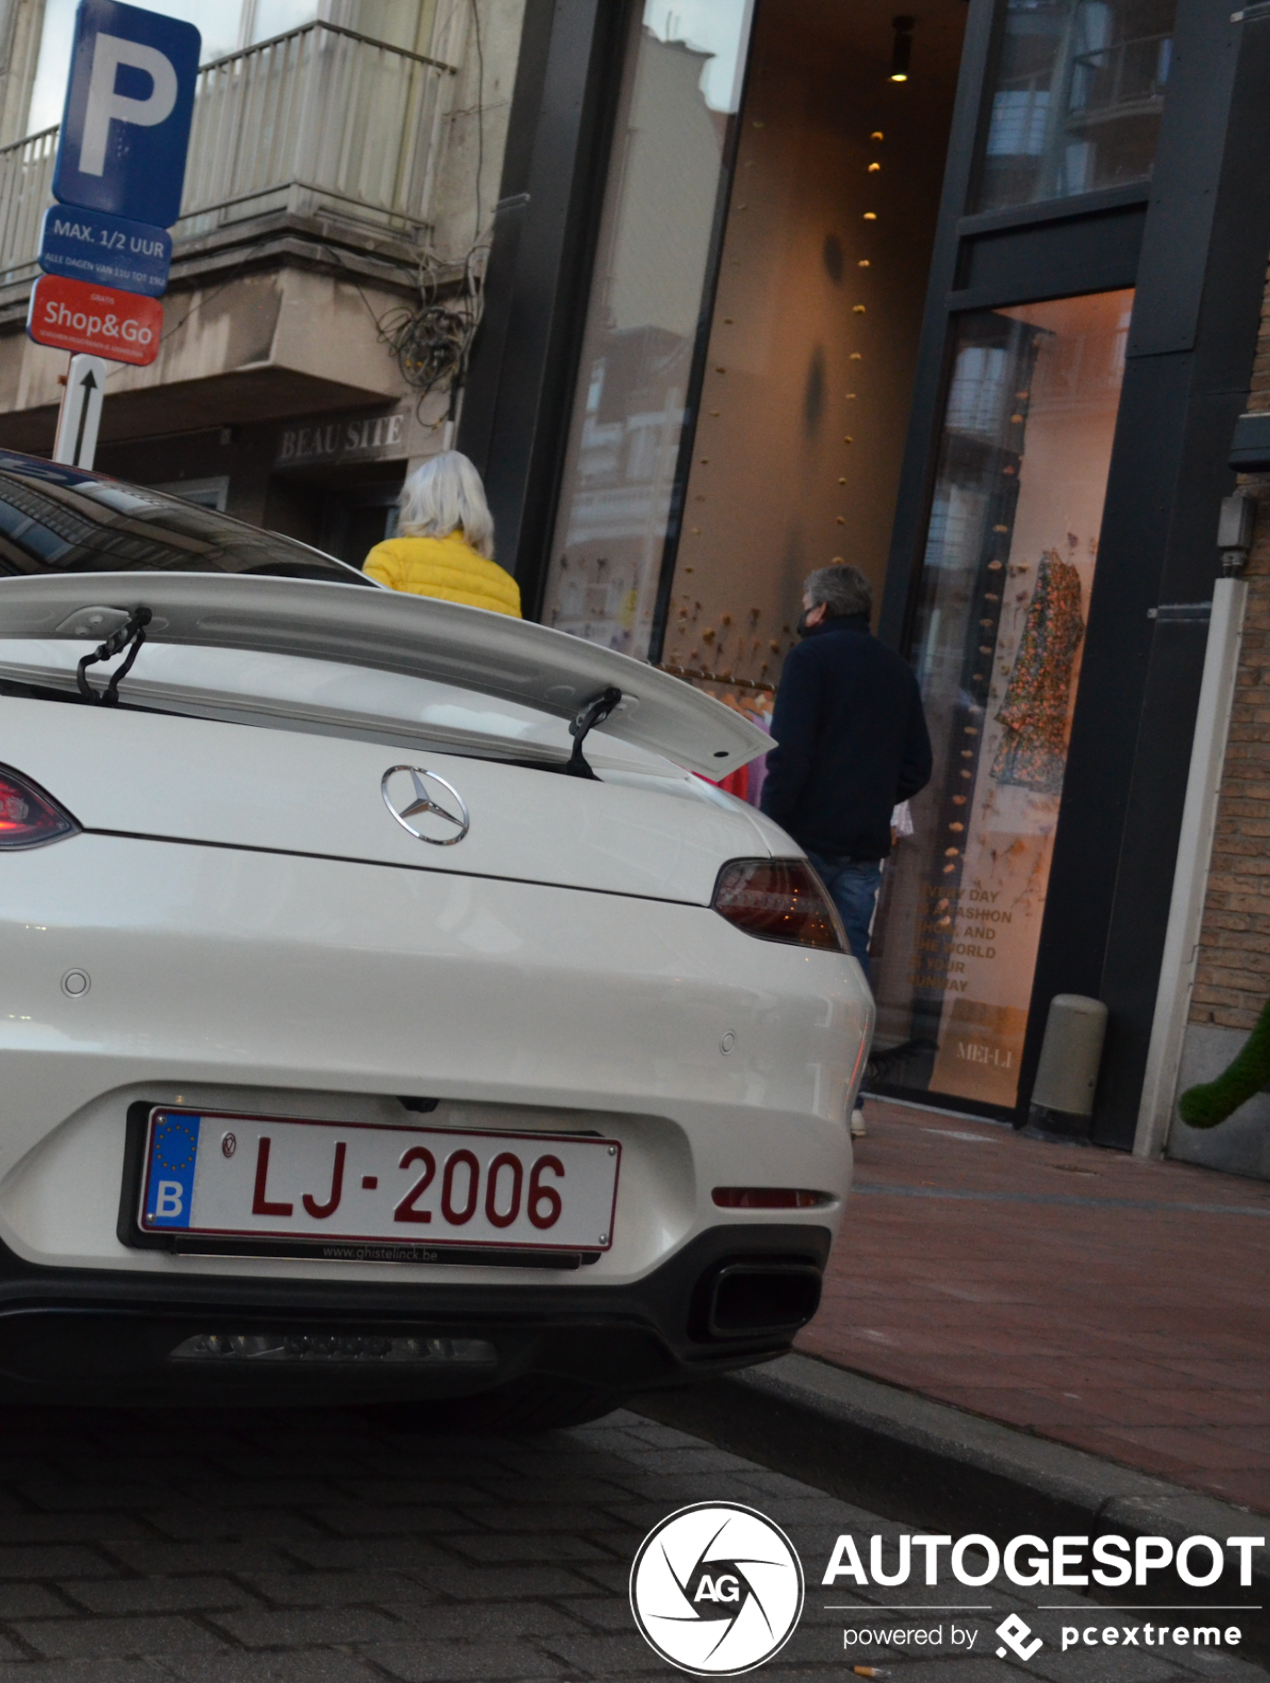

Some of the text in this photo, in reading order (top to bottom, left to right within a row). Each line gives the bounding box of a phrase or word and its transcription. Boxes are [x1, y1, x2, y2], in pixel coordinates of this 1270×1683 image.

[78, 32, 178, 177] P
[54, 219, 164, 258] MAX. 1/2 UUR
[45, 252, 63, 264] ALLE
[65, 256, 94, 271] DAGEN
[95, 262, 113, 275] VAN
[132, 271, 148, 281] TOT
[44, 301, 152, 345] Shop&Go
[280, 414, 404, 459] BEAU SITE
[969, 889, 1000, 904] DAY
[943, 943, 996, 960] WORLD
[964, 926, 996, 941] AND
[155, 1180, 184, 1218] B
[252, 1136, 566, 1230] LJ-2006
[323, 1245, 438, 1261] www.ghistelinck.be
